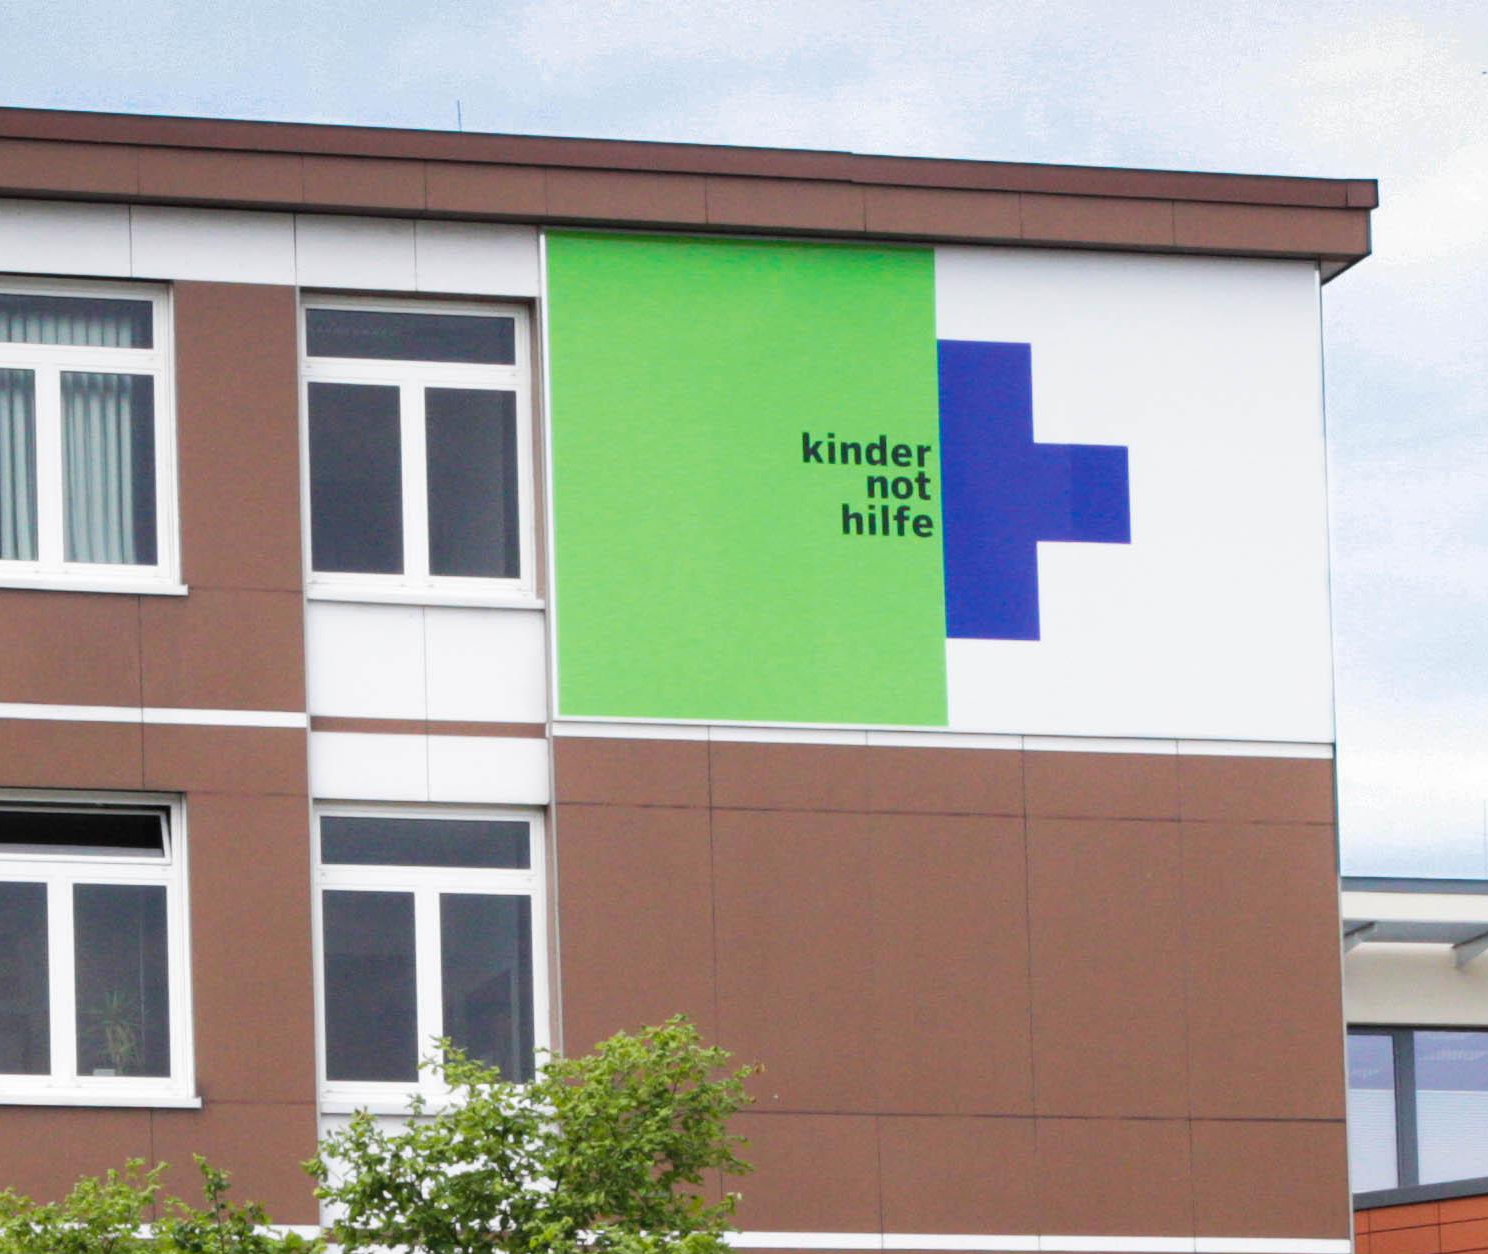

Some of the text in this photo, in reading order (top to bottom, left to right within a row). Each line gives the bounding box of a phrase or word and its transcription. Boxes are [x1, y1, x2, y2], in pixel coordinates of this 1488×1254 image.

[801, 432, 931, 467] kinder
[866, 471, 931, 501] not
[841, 503, 933, 538] hilfe
